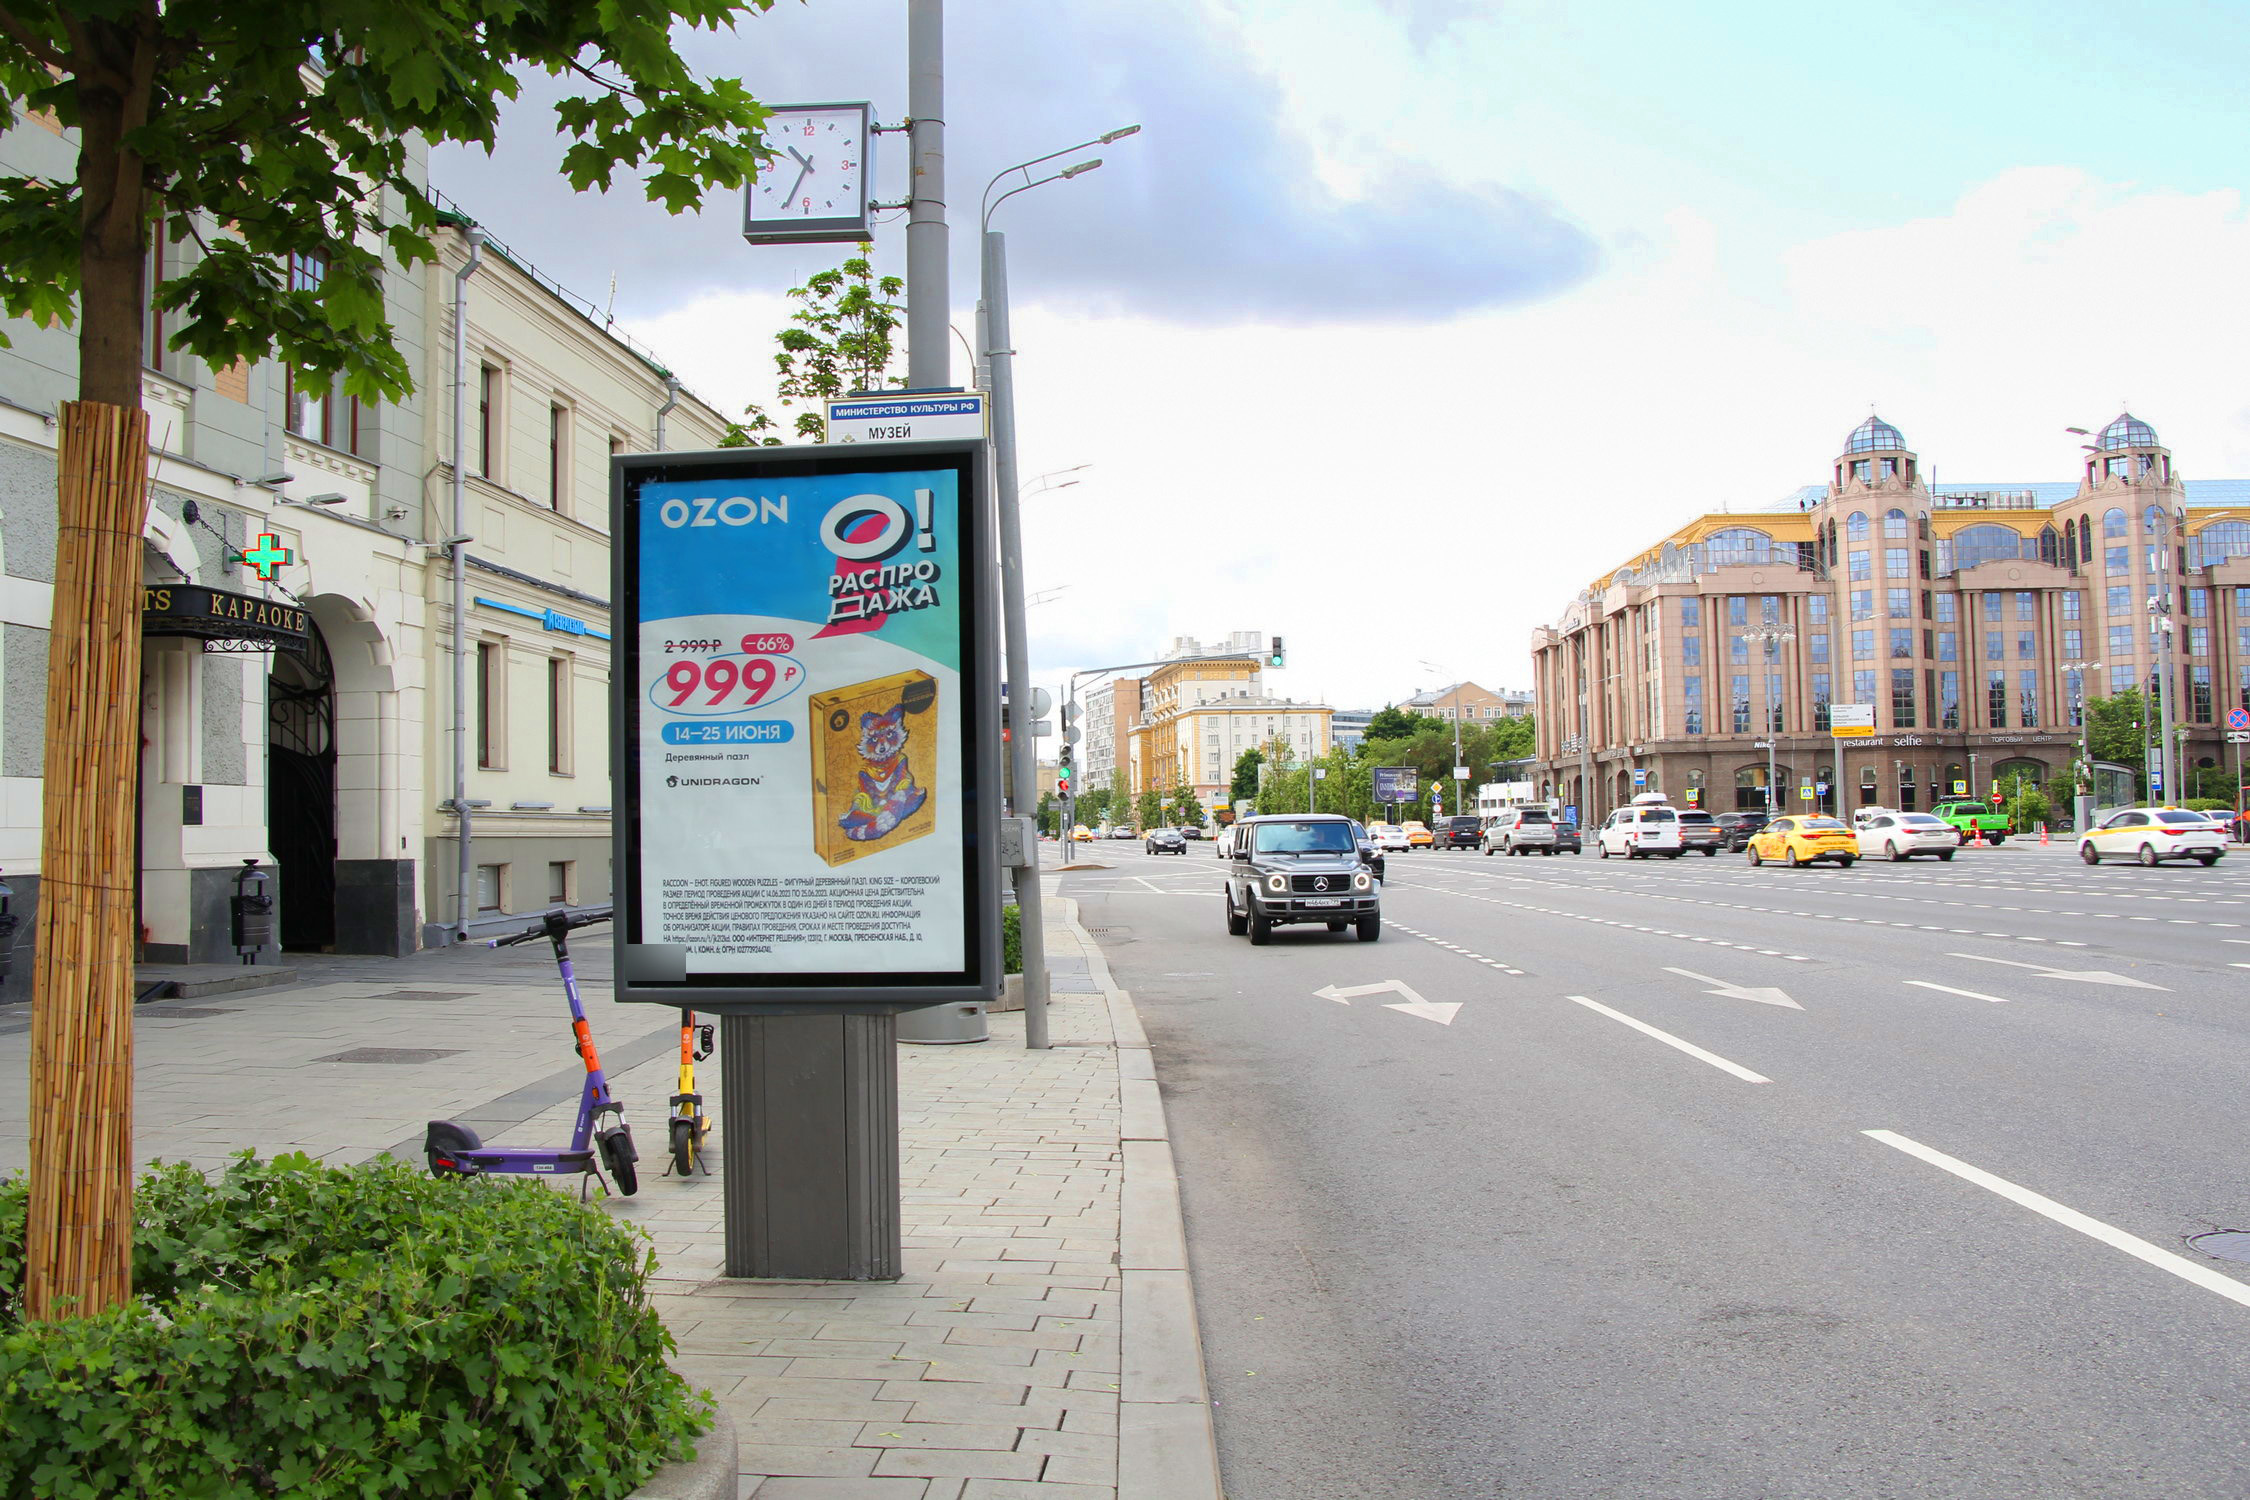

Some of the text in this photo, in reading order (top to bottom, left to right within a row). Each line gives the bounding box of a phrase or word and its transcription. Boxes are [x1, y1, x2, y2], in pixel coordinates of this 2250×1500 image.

[802, 126, 815, 137] 12
[766, 162, 774, 172] 9
[841, 160, 849, 170] 3
[802, 197, 810, 207] 6
[836, 402, 975, 417] МИНИСТЕРСТВО КУЛЬТУРЫ РФ
[868, 422, 911, 440] МУЗЕЙ
[660, 495, 788, 528] OZON
[828, 560, 940, 597] РАСПРО
[826, 584, 939, 624] ДАЖА
[210, 593, 305, 632] КАРАОКЕ
[666, 658, 776, 707] 999
[725, 725, 780, 740] ИЮНЯ
[1844, 738, 1883, 747] restaurant
[1894, 735, 1922, 746] selfie
[665, 752, 723, 763] Деревянный
[681, 778, 760, 786] UNIDRAGON
[784, 877, 814, 886] ФИГУРНЫЙ
[815, 876, 851, 886] ДЕРЕВЯННЫЙ
[684, 890, 705, 898] ПЕРИОД
[706, 890, 740, 898] ПРОВЕДЕНИЯ
[742, 889, 760, 898] АКЦИИ
[829, 889, 864, 897] АКЦИОННАЯ
[864, 888, 879, 897] ЦЕНА
[711, 900, 743, 908] ВРЕМЕННОЙ
[787, 901, 803, 909] ОДИН
[813, 899, 827, 909] ДНЕЙ
[833, 900, 855, 909] ПЕРИОД
[856, 900, 892, 908] ПРОВЕДЕНИЯ
[702, 911, 729, 920] ДЕЙСТВИЯ
[731, 912, 759, 920] ЦЕНОВОГО
[838, 910, 855, 919] САЙТЕ
[882, 911, 921, 919] ИНФОРМАЦИЯ
[845, 922, 880, 931] ПРОВЕДЕНИЯ
[881, 922, 911, 931] ДОСТУПНА
